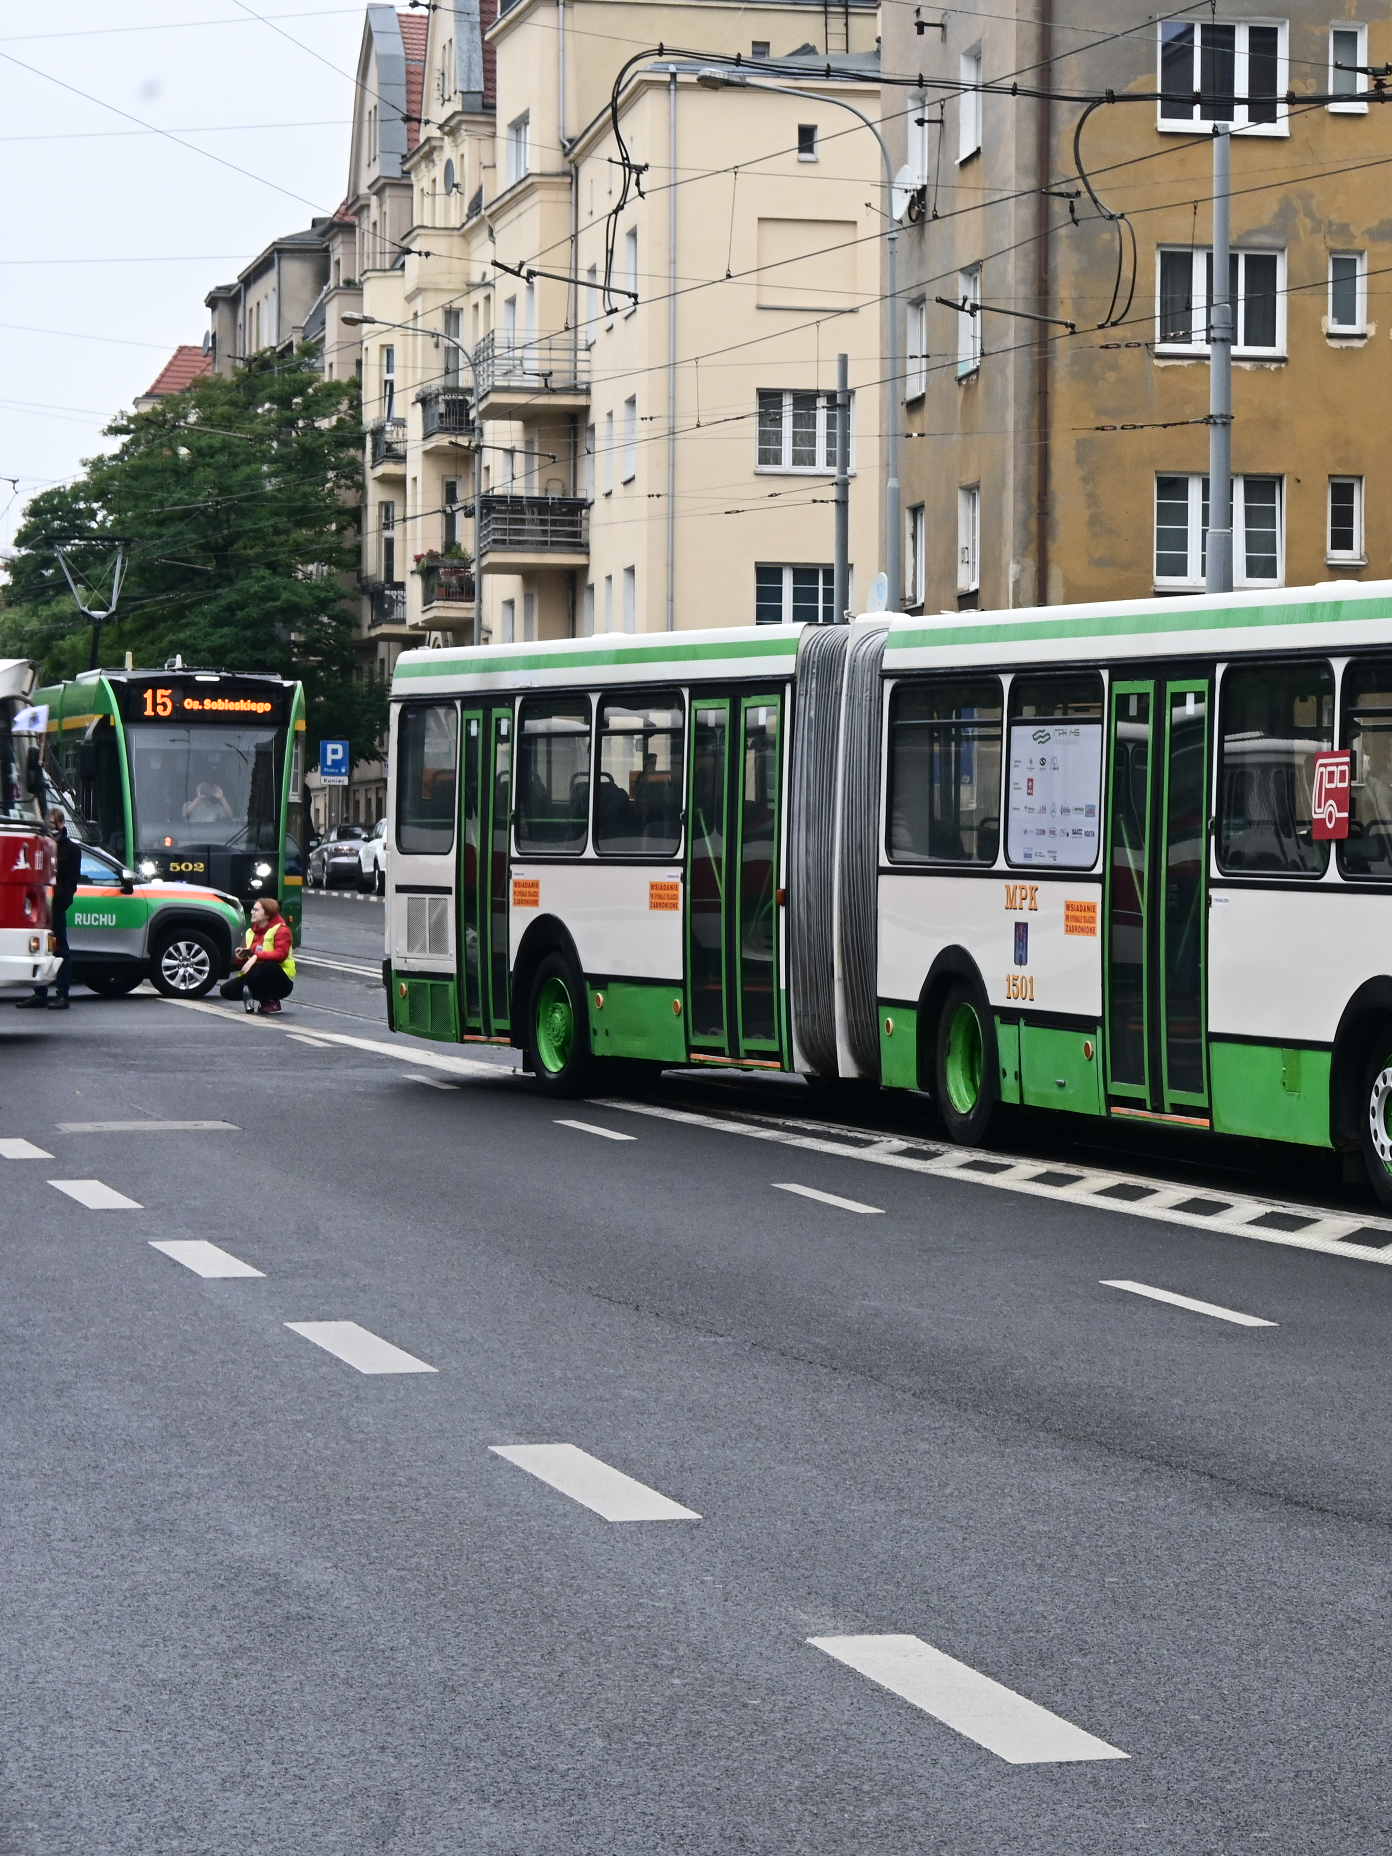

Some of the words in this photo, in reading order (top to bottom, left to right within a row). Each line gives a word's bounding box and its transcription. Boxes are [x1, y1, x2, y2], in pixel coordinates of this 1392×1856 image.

[143, 688, 173, 717] 15
[203, 698, 272, 713] Sobieskiego
[326, 743, 343, 766] P
[1004, 884, 1039, 911] MPK
[74, 912, 116, 926] RUCHU
[1006, 974, 1035, 1001] 1501
